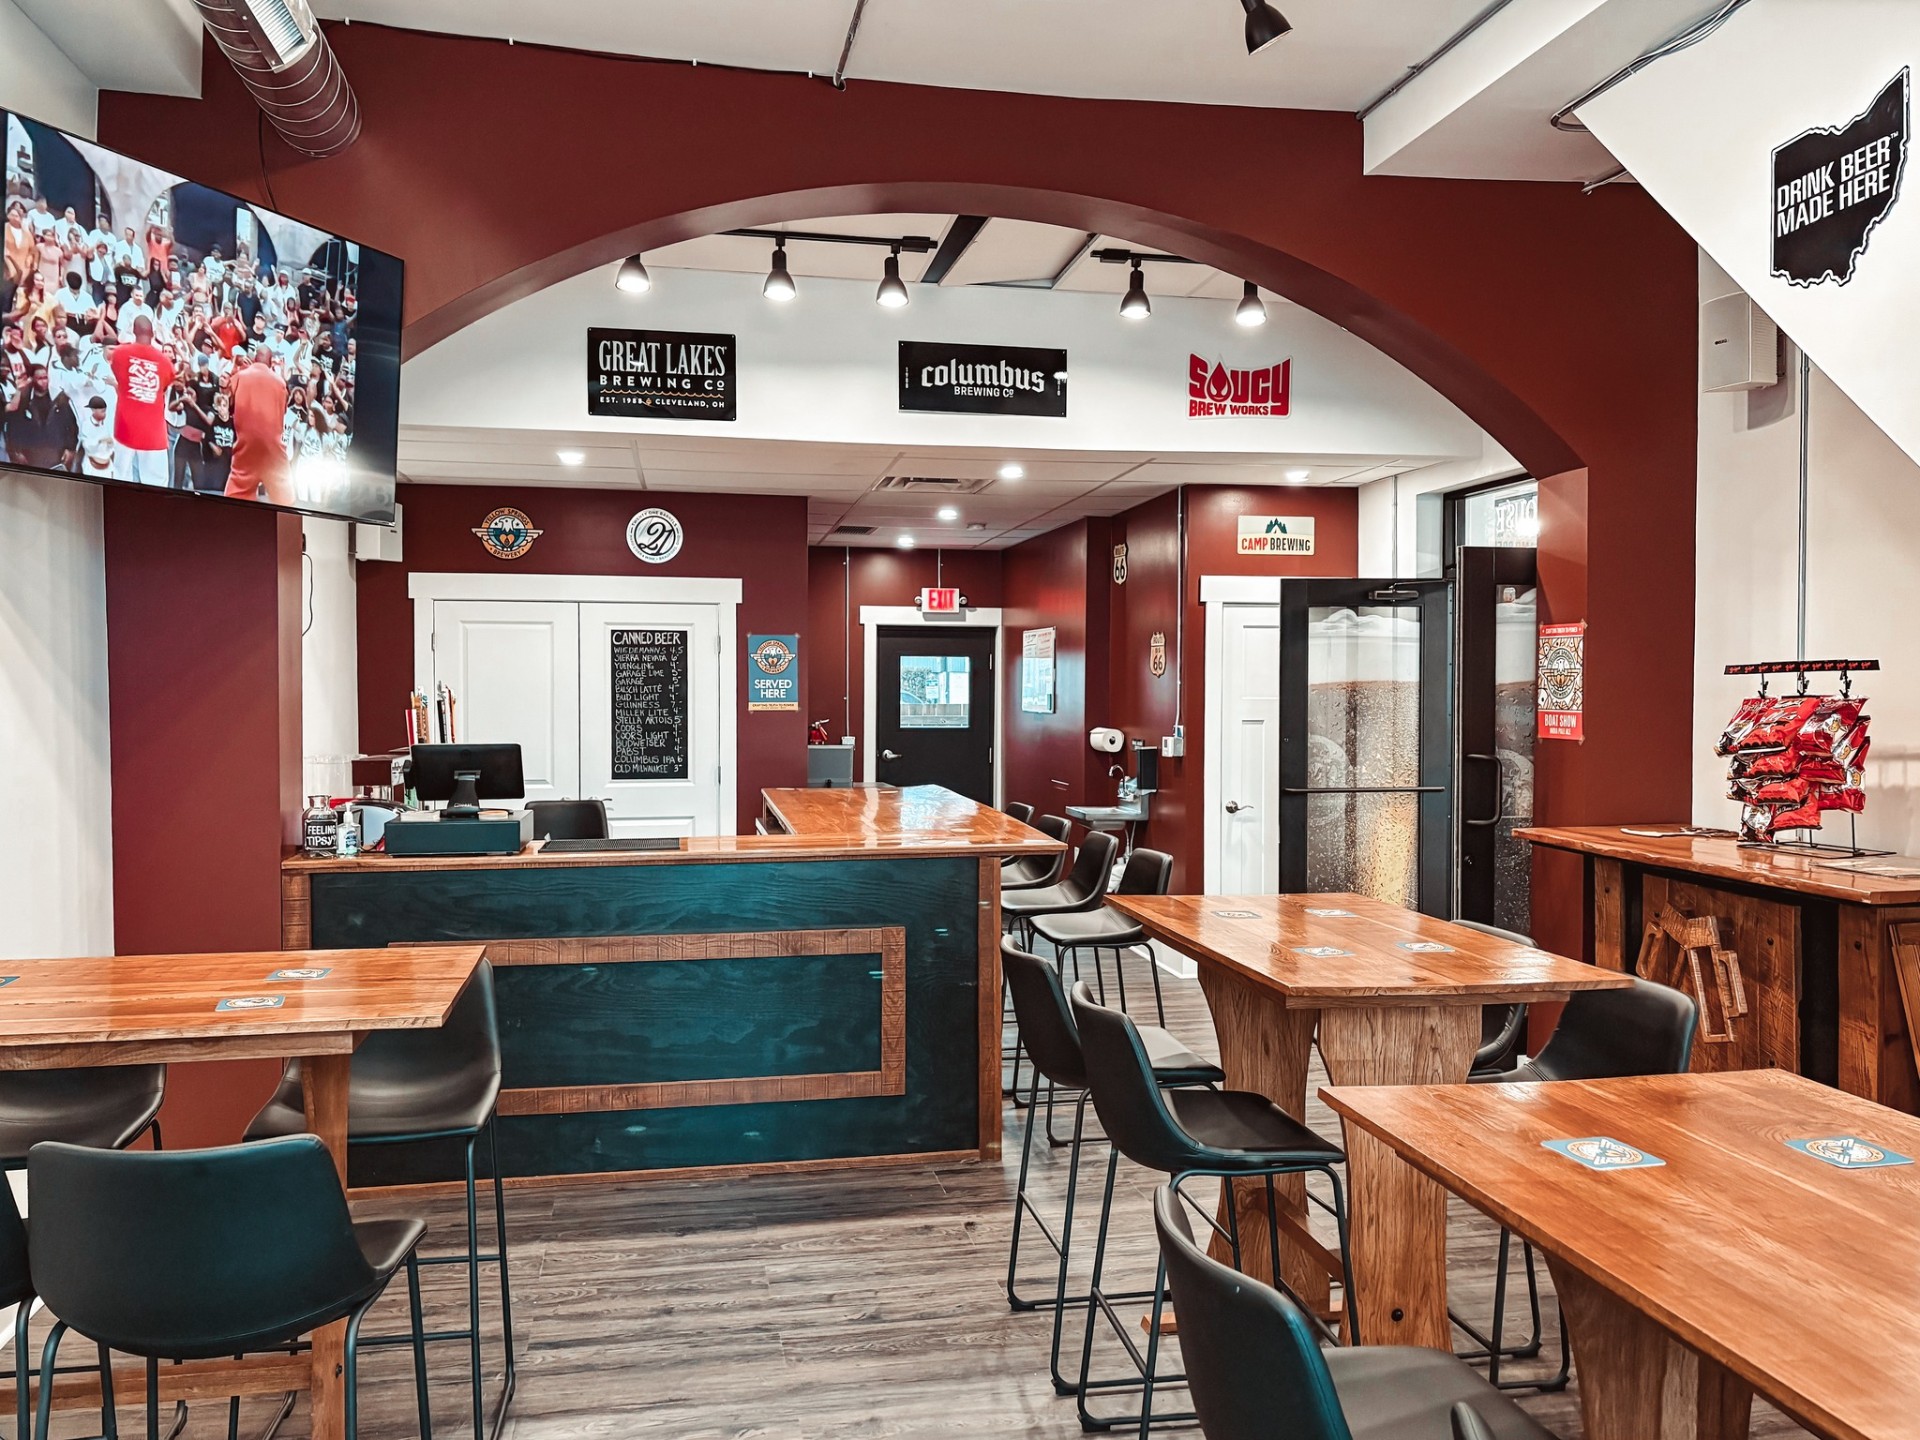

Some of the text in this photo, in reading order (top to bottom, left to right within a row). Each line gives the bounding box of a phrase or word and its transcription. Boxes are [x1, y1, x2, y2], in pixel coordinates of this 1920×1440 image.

[1778, 161, 1835, 212] DRINK
[1777, 163, 1890, 237] MADE HERE
[600, 340, 726, 376] GREAT LAKES
[600, 375, 691, 388] BREWING
[921, 359, 1044, 392] columbus
[954, 386, 1000, 397] BREWING
[655, 398, 709, 408] CLEVELAND,
[1189, 400, 1269, 416] BREW WORKS
[1242, 537, 1310, 551] CAMP BREWING
[493, 550, 520, 558] BREWERY
[1115, 559, 1125, 580] 66
[928, 590, 955, 610] EXIT
[613, 632, 681, 645] CANNED BEER
[1153, 655, 1162, 670] 66
[754, 679, 792, 689] SERVED
[760, 689, 786, 698] HERE
[616, 716, 642, 724] STELLA
[1545, 714, 1576, 728] BOAT SHOW
[616, 747, 646, 756] PABST
[615, 755, 659, 764] COLUMBUS
[663, 756, 675, 764] IPA
[615, 764, 631, 773] OLD
[632, 764, 668, 773] MILWAUKEE
